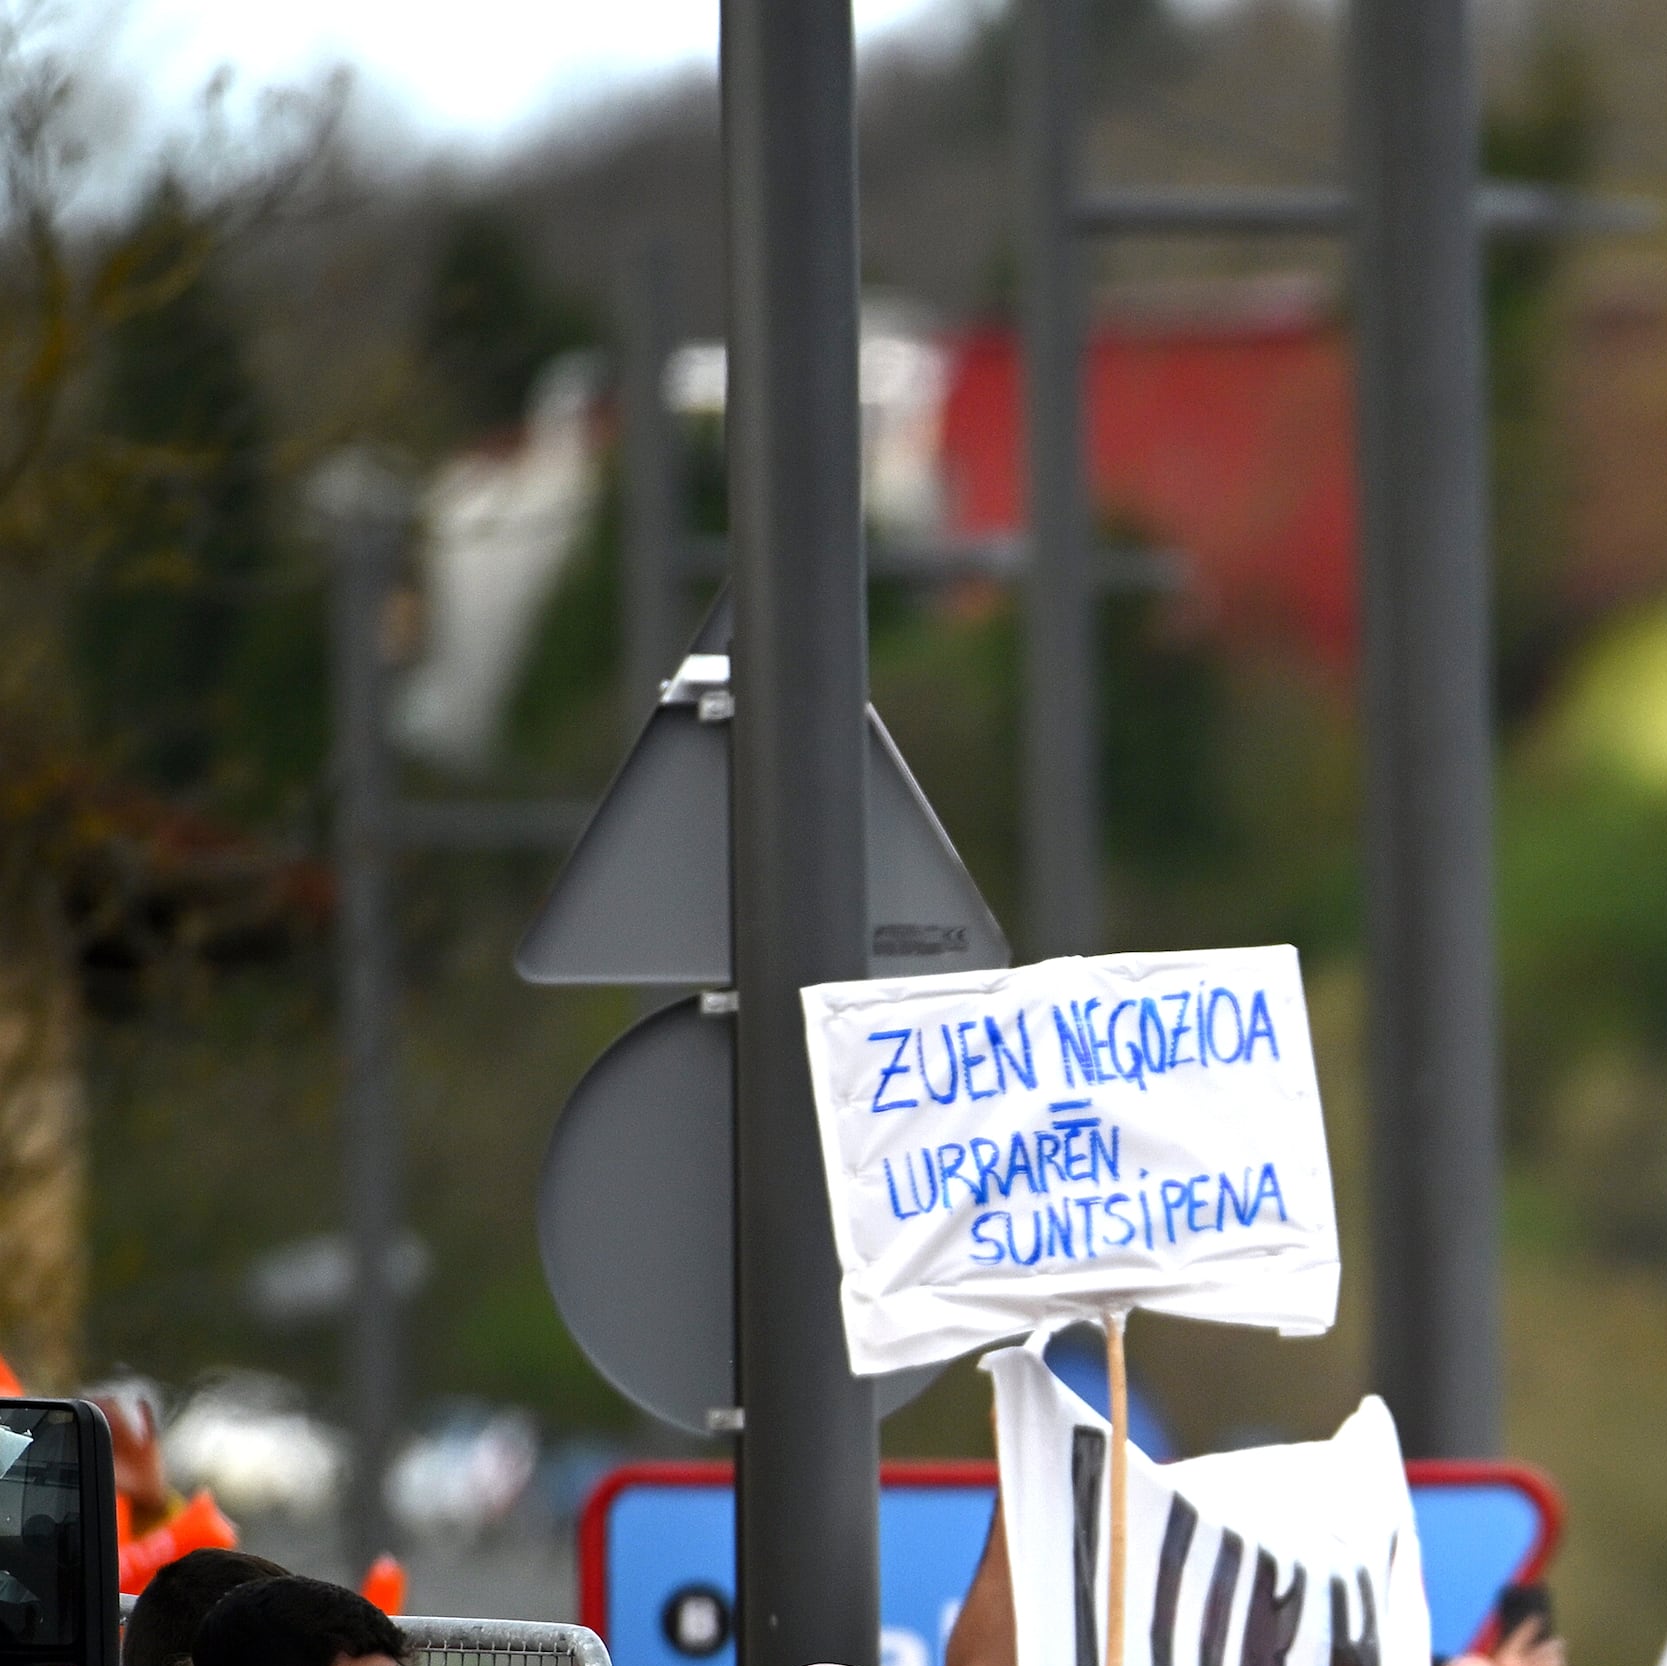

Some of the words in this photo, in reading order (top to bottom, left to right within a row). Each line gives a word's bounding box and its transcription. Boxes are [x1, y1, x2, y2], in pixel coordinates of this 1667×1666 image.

[867, 1006, 1036, 1114] ZUEN
[1053, 981, 1281, 1092] NEGOZIOA
[883, 1125, 1121, 1221] LURRAREN
[969, 1162, 1289, 1266] SUNTSIPENA
